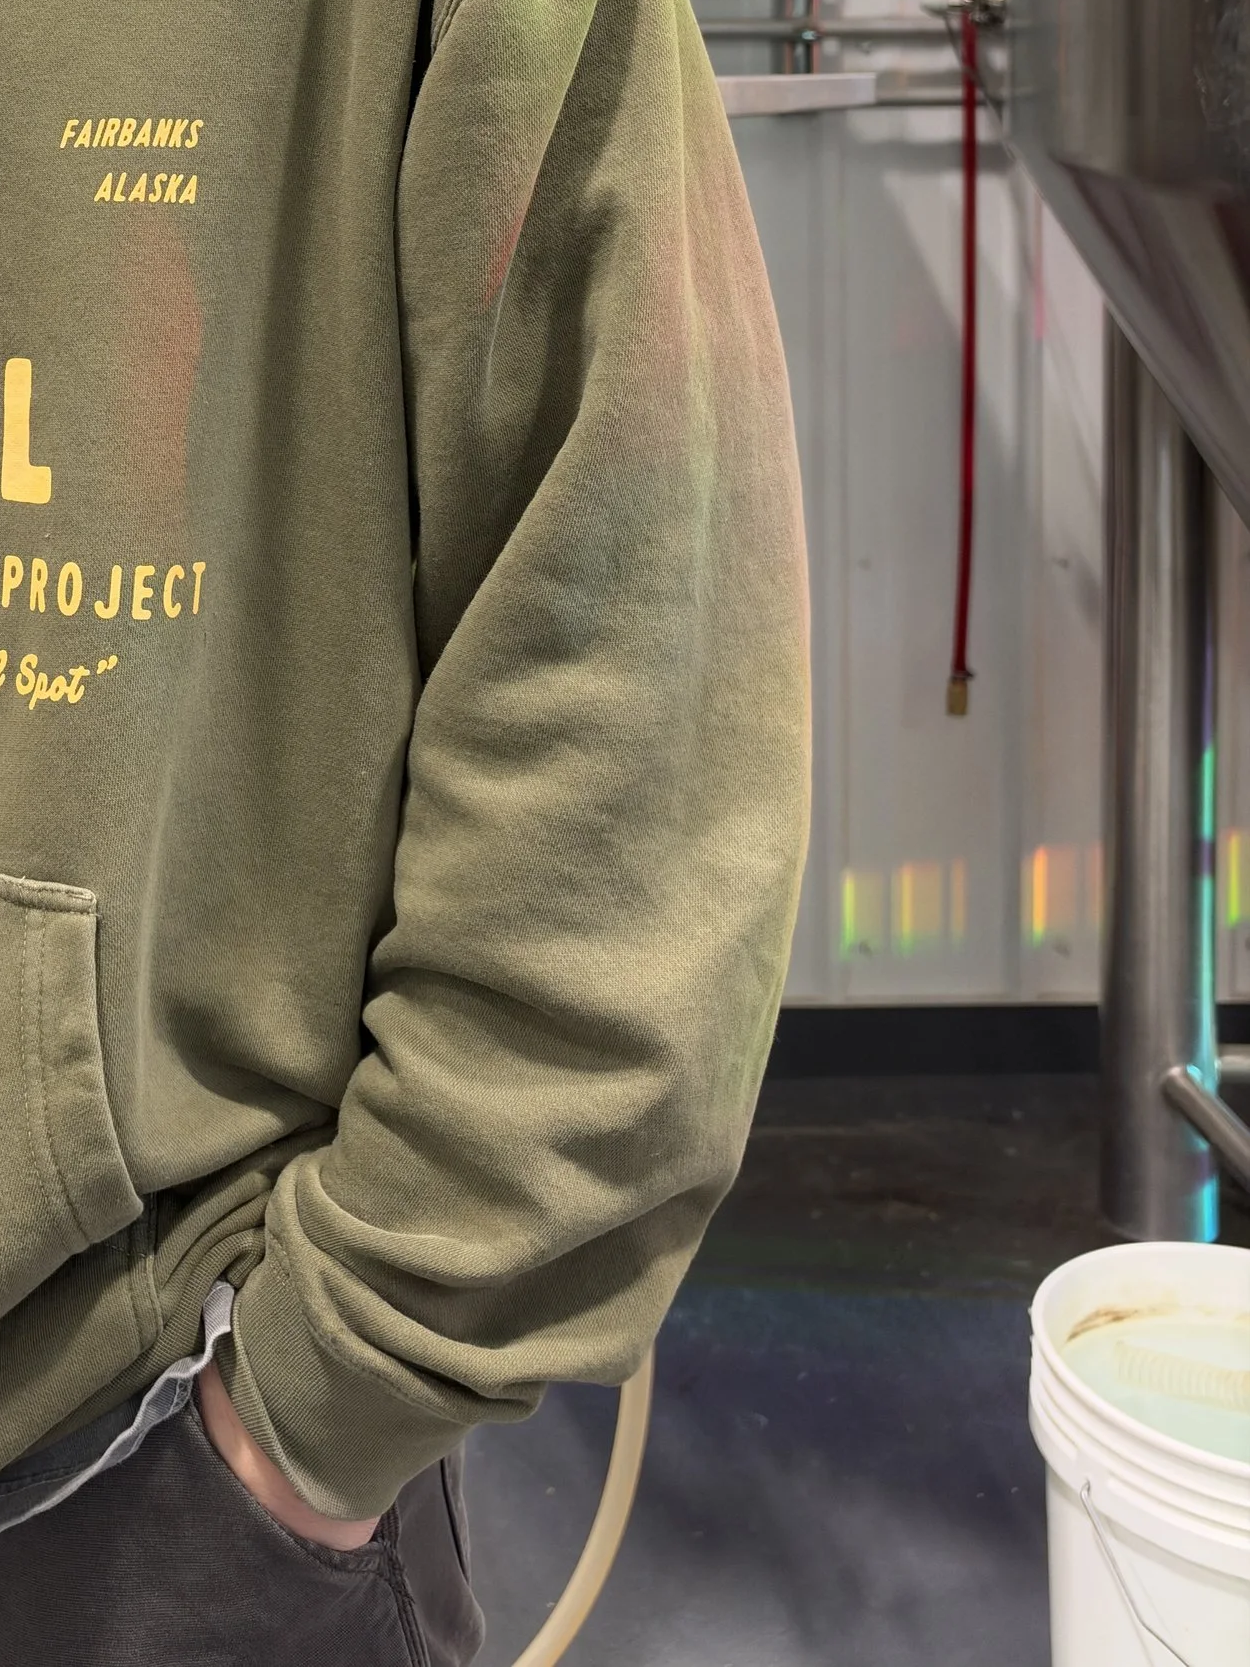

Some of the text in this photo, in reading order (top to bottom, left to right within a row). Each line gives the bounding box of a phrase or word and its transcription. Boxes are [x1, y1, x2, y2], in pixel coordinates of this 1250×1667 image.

[59, 117, 204, 150] FAIRBANKS
[94, 172, 198, 204] ALASKA
[1, 554, 207, 621] PROJECT
